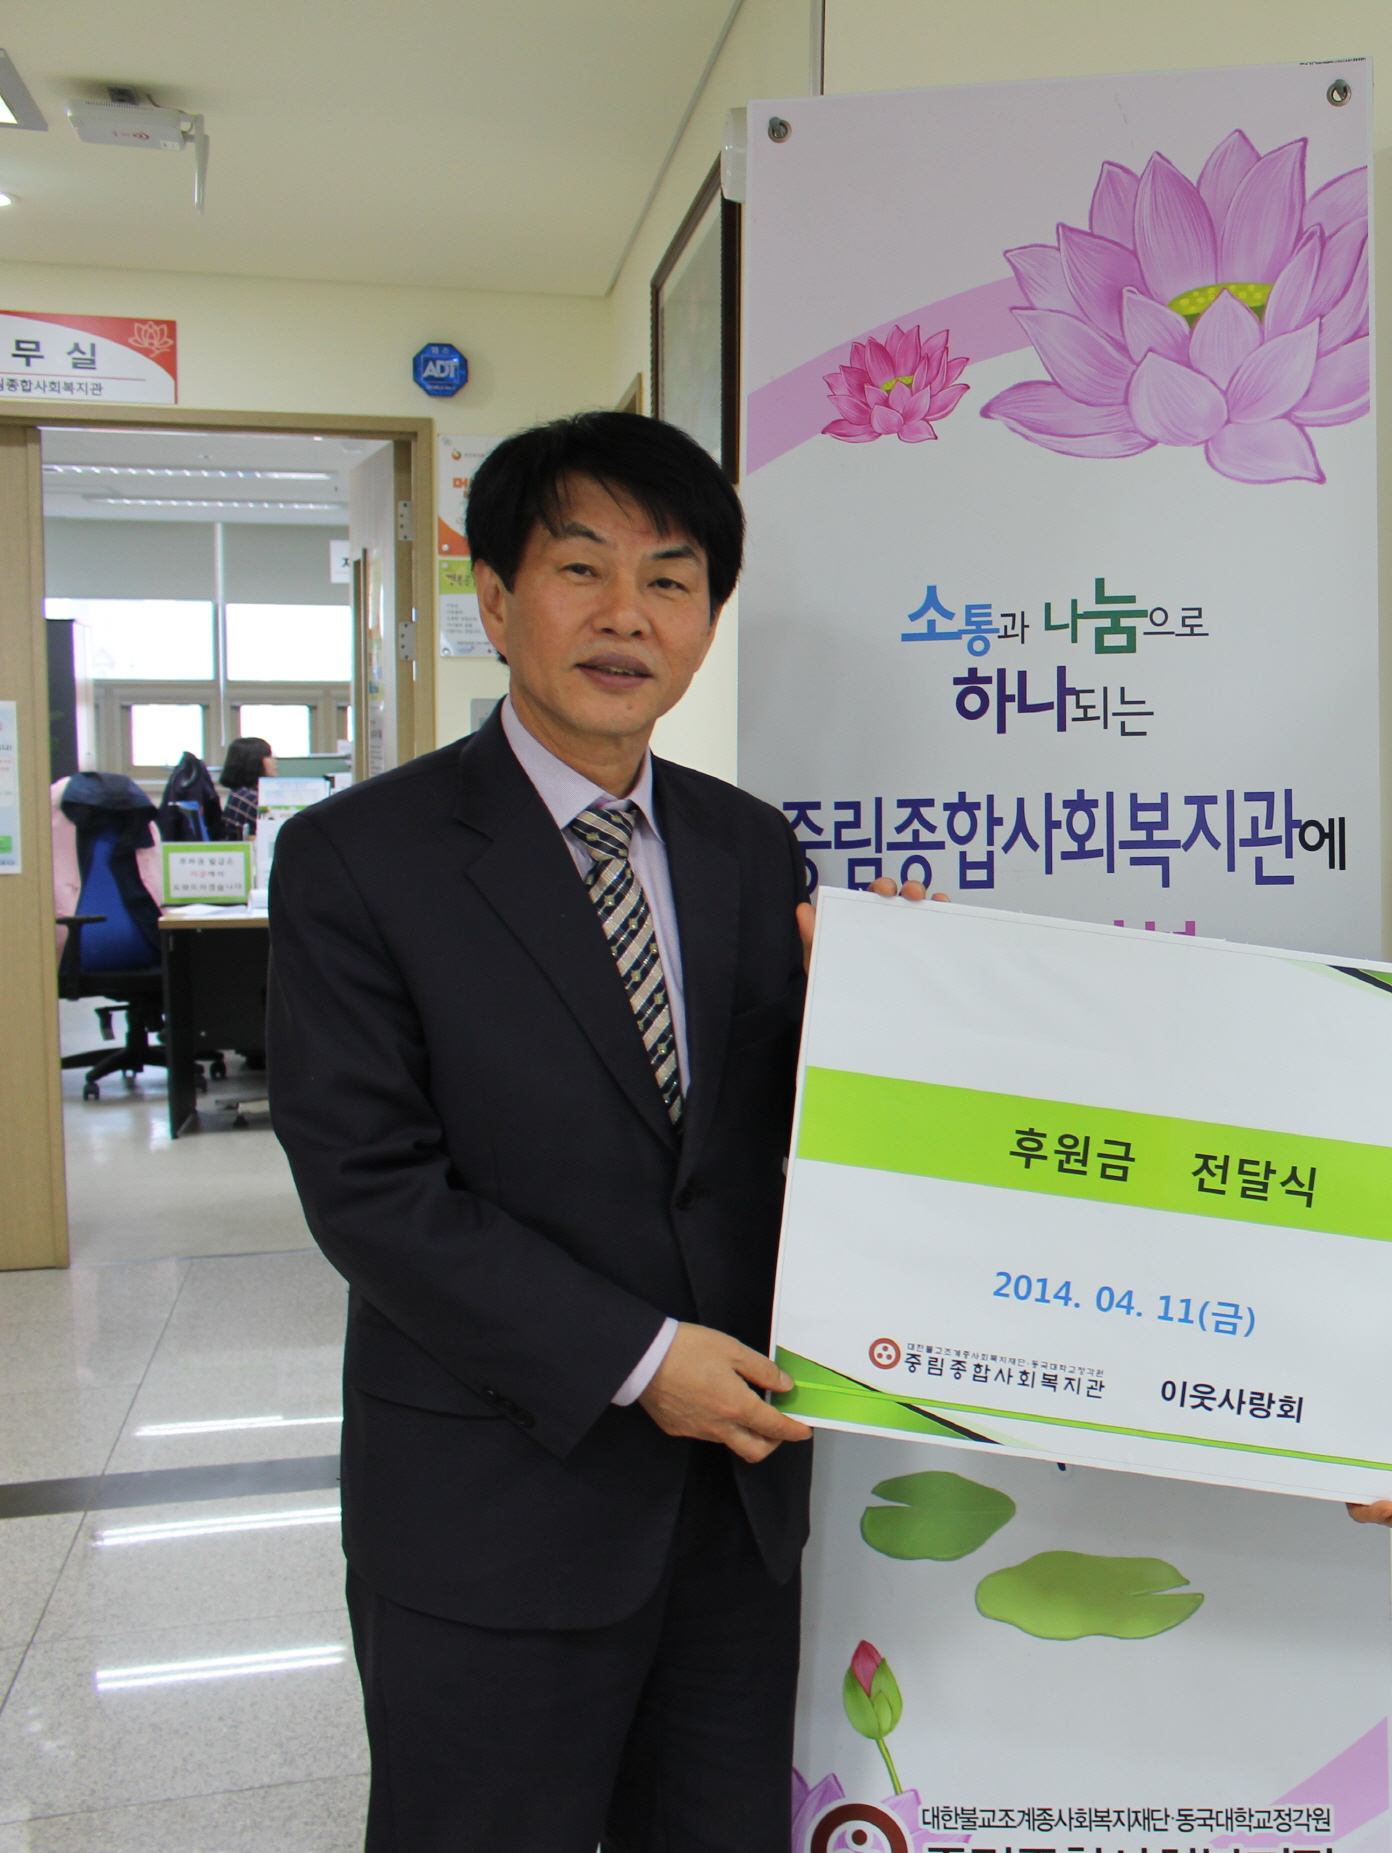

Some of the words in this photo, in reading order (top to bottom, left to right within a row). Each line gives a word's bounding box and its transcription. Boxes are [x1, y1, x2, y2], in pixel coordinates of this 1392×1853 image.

[422, 360, 459, 378] ADT
[901, 585, 1030, 657] 소통과
[1044, 577, 1209, 654] 나눔으로
[953, 665, 1154, 736] 하나되는
[782, 788, 1346, 893] 중림종합사회복지관에
[1008, 1125, 1138, 1184] 후원금
[1191, 1149, 1319, 1209] 전달식
[992, 1270, 1081, 1311] 2014.
[1094, 1285, 1143, 1318] 04.
[1157, 1294, 1257, 1339] 11(금)
[904, 1352, 1106, 1400] 중림종합사회복지관
[1159, 1378, 1304, 1425] 이웃사랑회
